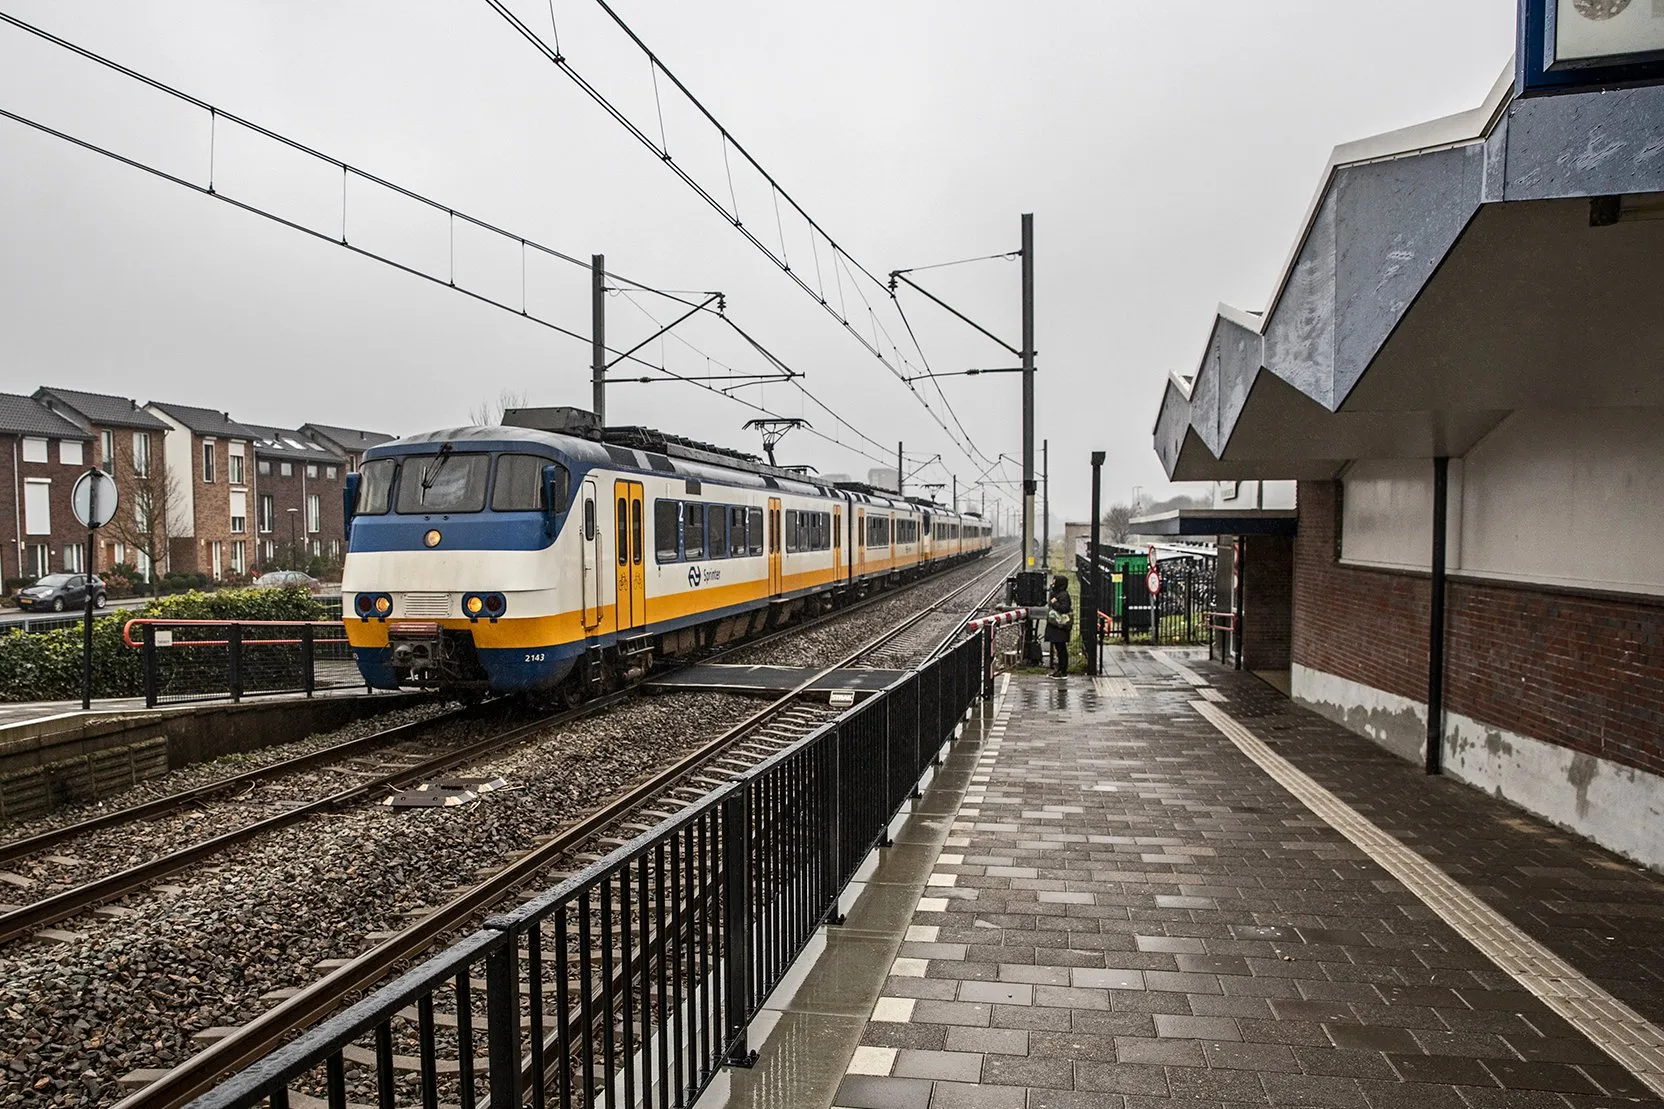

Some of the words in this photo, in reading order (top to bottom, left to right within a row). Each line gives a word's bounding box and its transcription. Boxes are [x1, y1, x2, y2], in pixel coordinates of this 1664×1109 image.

[678, 501, 684, 522] 2
[703, 568, 721, 584] Sprinter
[524, 653, 545, 662] 2143
